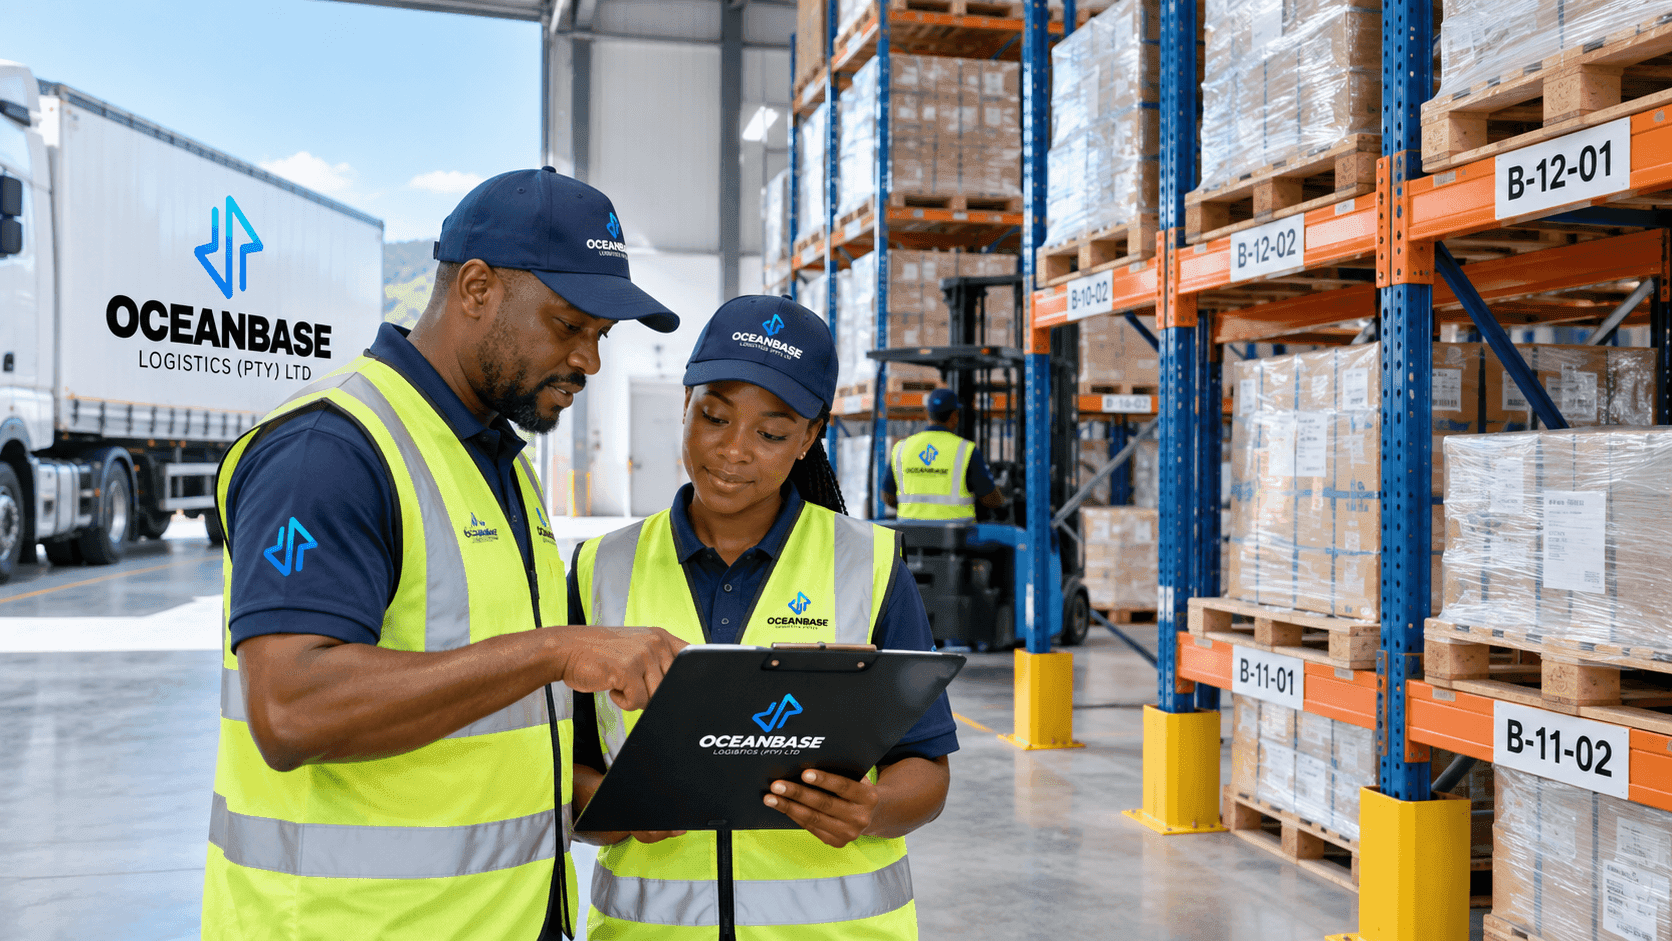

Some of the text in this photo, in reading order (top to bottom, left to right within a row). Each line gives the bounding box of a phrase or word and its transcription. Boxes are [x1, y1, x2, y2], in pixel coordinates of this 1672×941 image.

[1507, 139, 1612, 202] B-12-01
[1237, 228, 1296, 269] B-12-02
[1071, 280, 1108, 310] B-10-02
[106, 294, 332, 360] OCEANBASE
[731, 331, 803, 360] OCEANBASE
[138, 349, 312, 382] LOGISTICS (PTY) LTD
[767, 616, 829, 627] OCEANBASE
[1240, 657, 1294, 696] B-11-01
[699, 734, 826, 749] OCEANBASE
[1507, 718, 1613, 779] B-11-02
